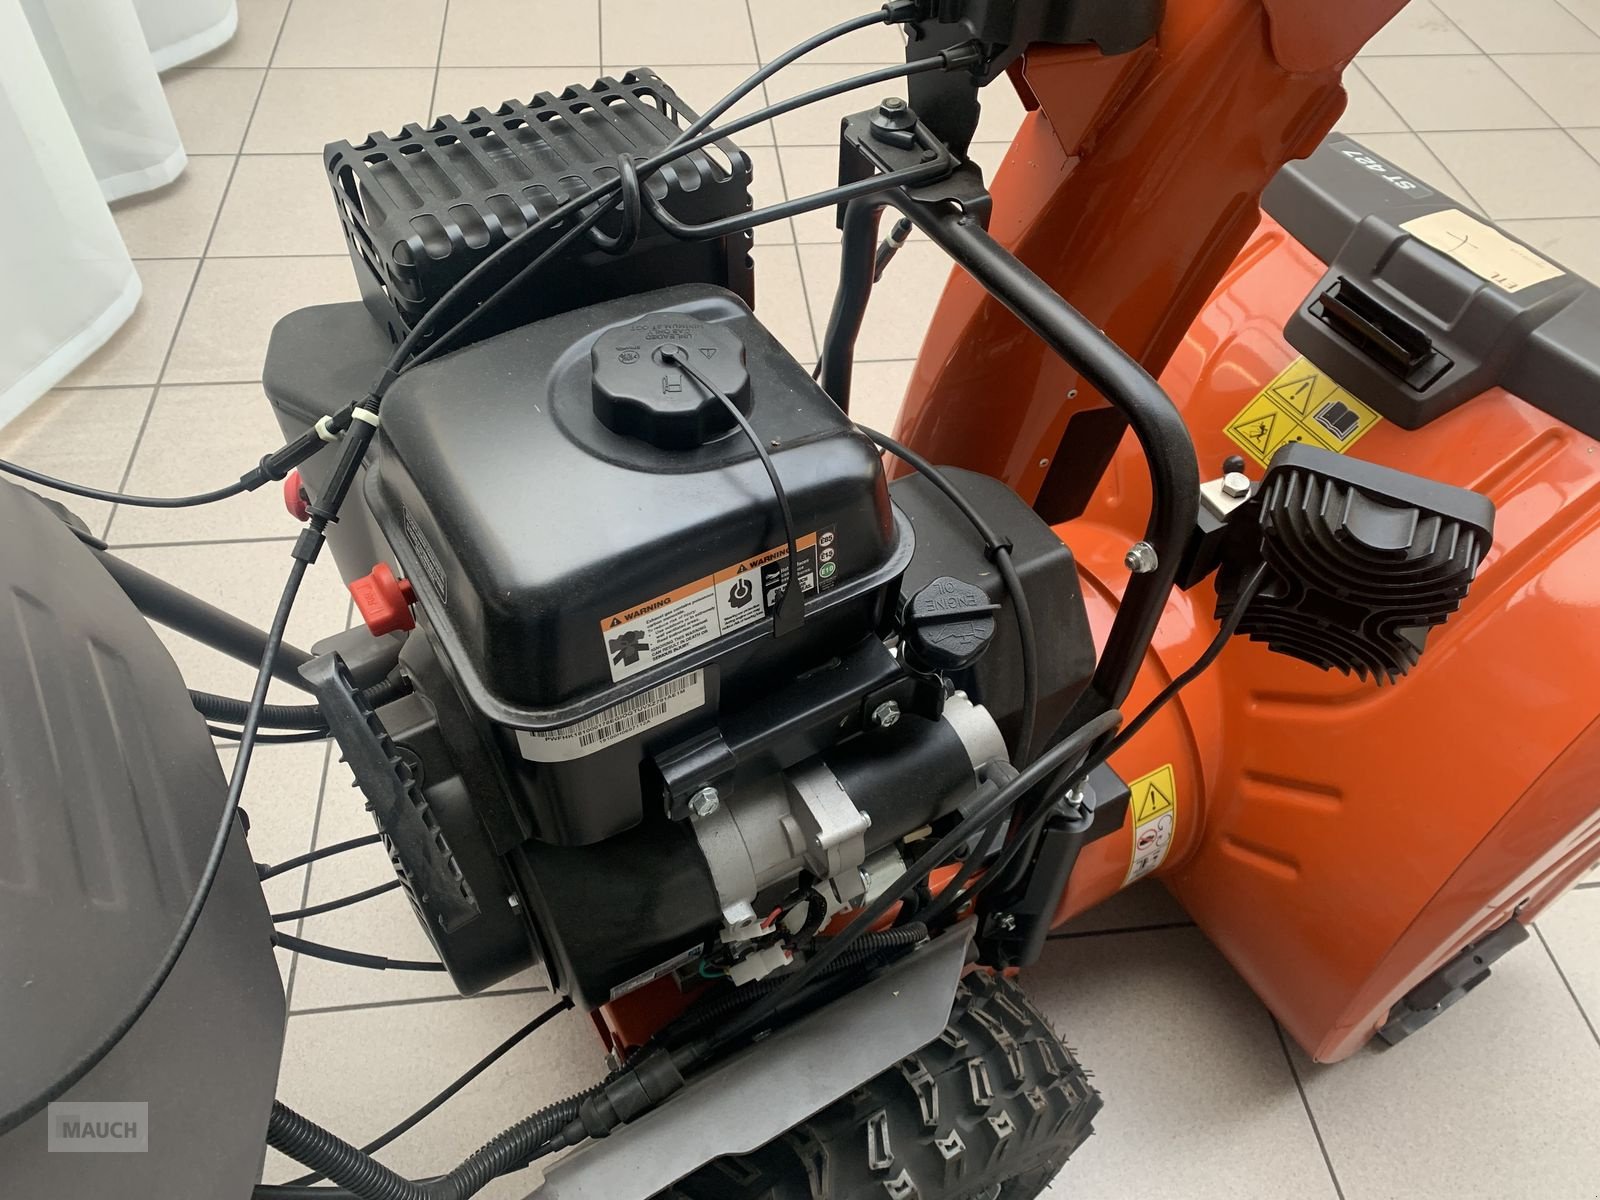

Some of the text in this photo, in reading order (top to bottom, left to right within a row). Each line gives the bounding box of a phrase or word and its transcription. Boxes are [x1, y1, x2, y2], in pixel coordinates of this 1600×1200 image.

[1341, 149, 1417, 190] ST 427
[821, 564, 834, 575] E10
[933, 581, 955, 595] OIL
[624, 596, 671, 621] WARNING
[925, 595, 977, 612] ENGINE
